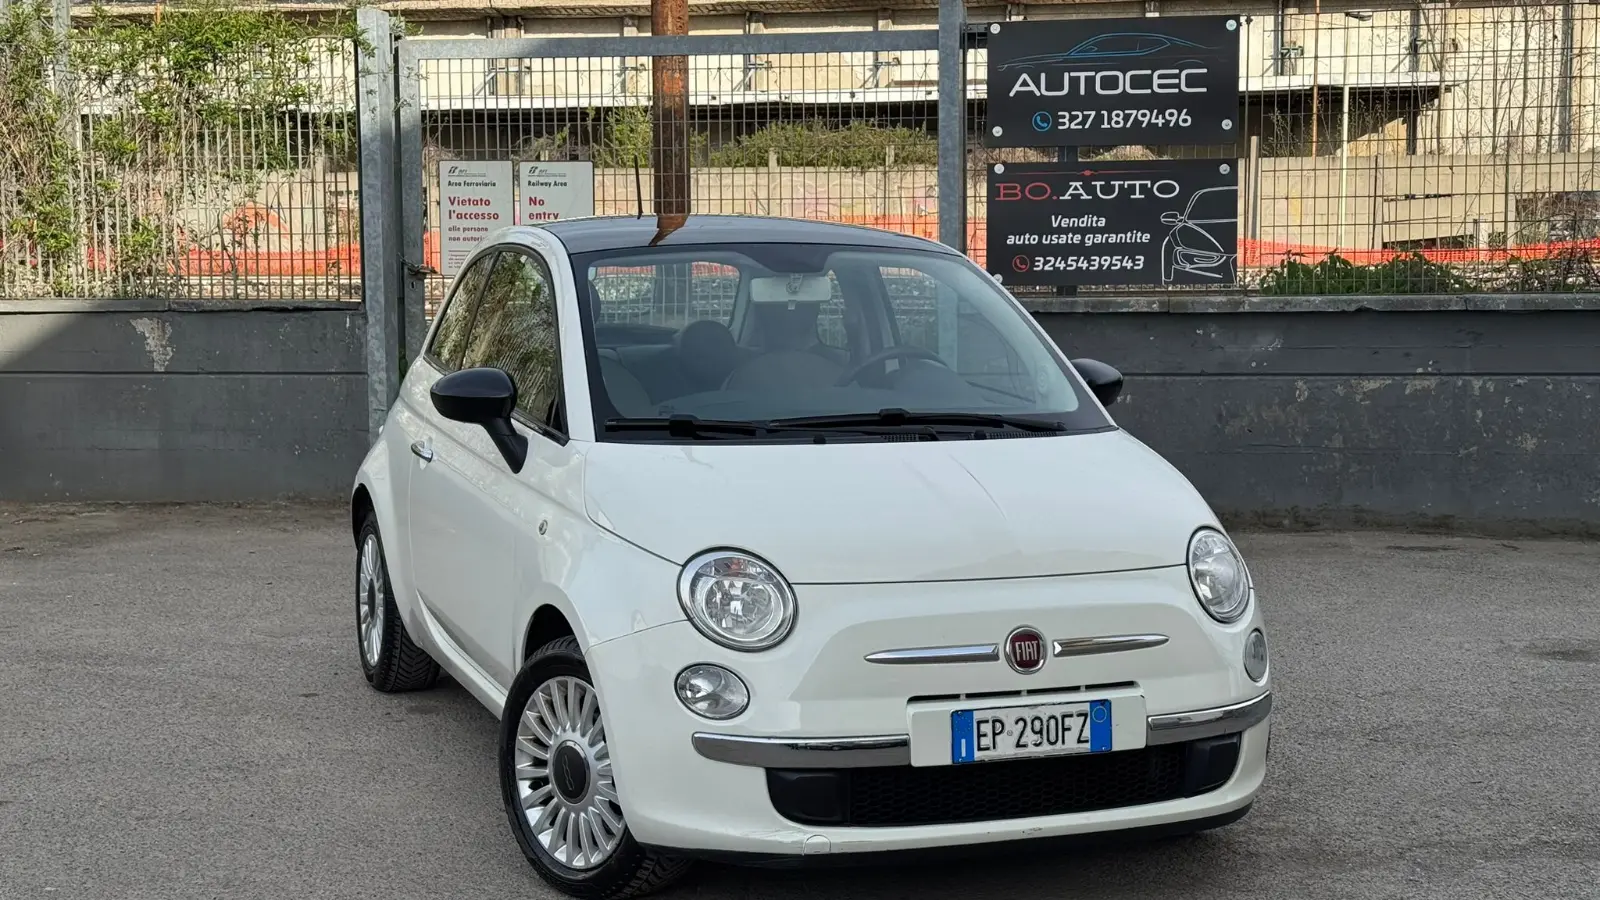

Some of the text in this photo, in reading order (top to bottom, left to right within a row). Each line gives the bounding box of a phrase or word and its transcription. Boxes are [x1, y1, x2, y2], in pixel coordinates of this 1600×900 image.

[1009, 68, 1208, 97] AUTOCEC
[1057, 108, 1192, 130] 327 1879496
[528, 180, 551, 188] Railway
[995, 180, 1180, 200] BO.AUTO
[448, 196, 491, 206] Vietato
[528, 196, 545, 206] No
[448, 209, 499, 220] l'accesso
[1051, 215, 1106, 228] Vendita
[1006, 231, 1150, 246] auto usate garantite
[1033, 255, 1145, 271] 3245439543
[1015, 640, 1039, 662] FIAT
